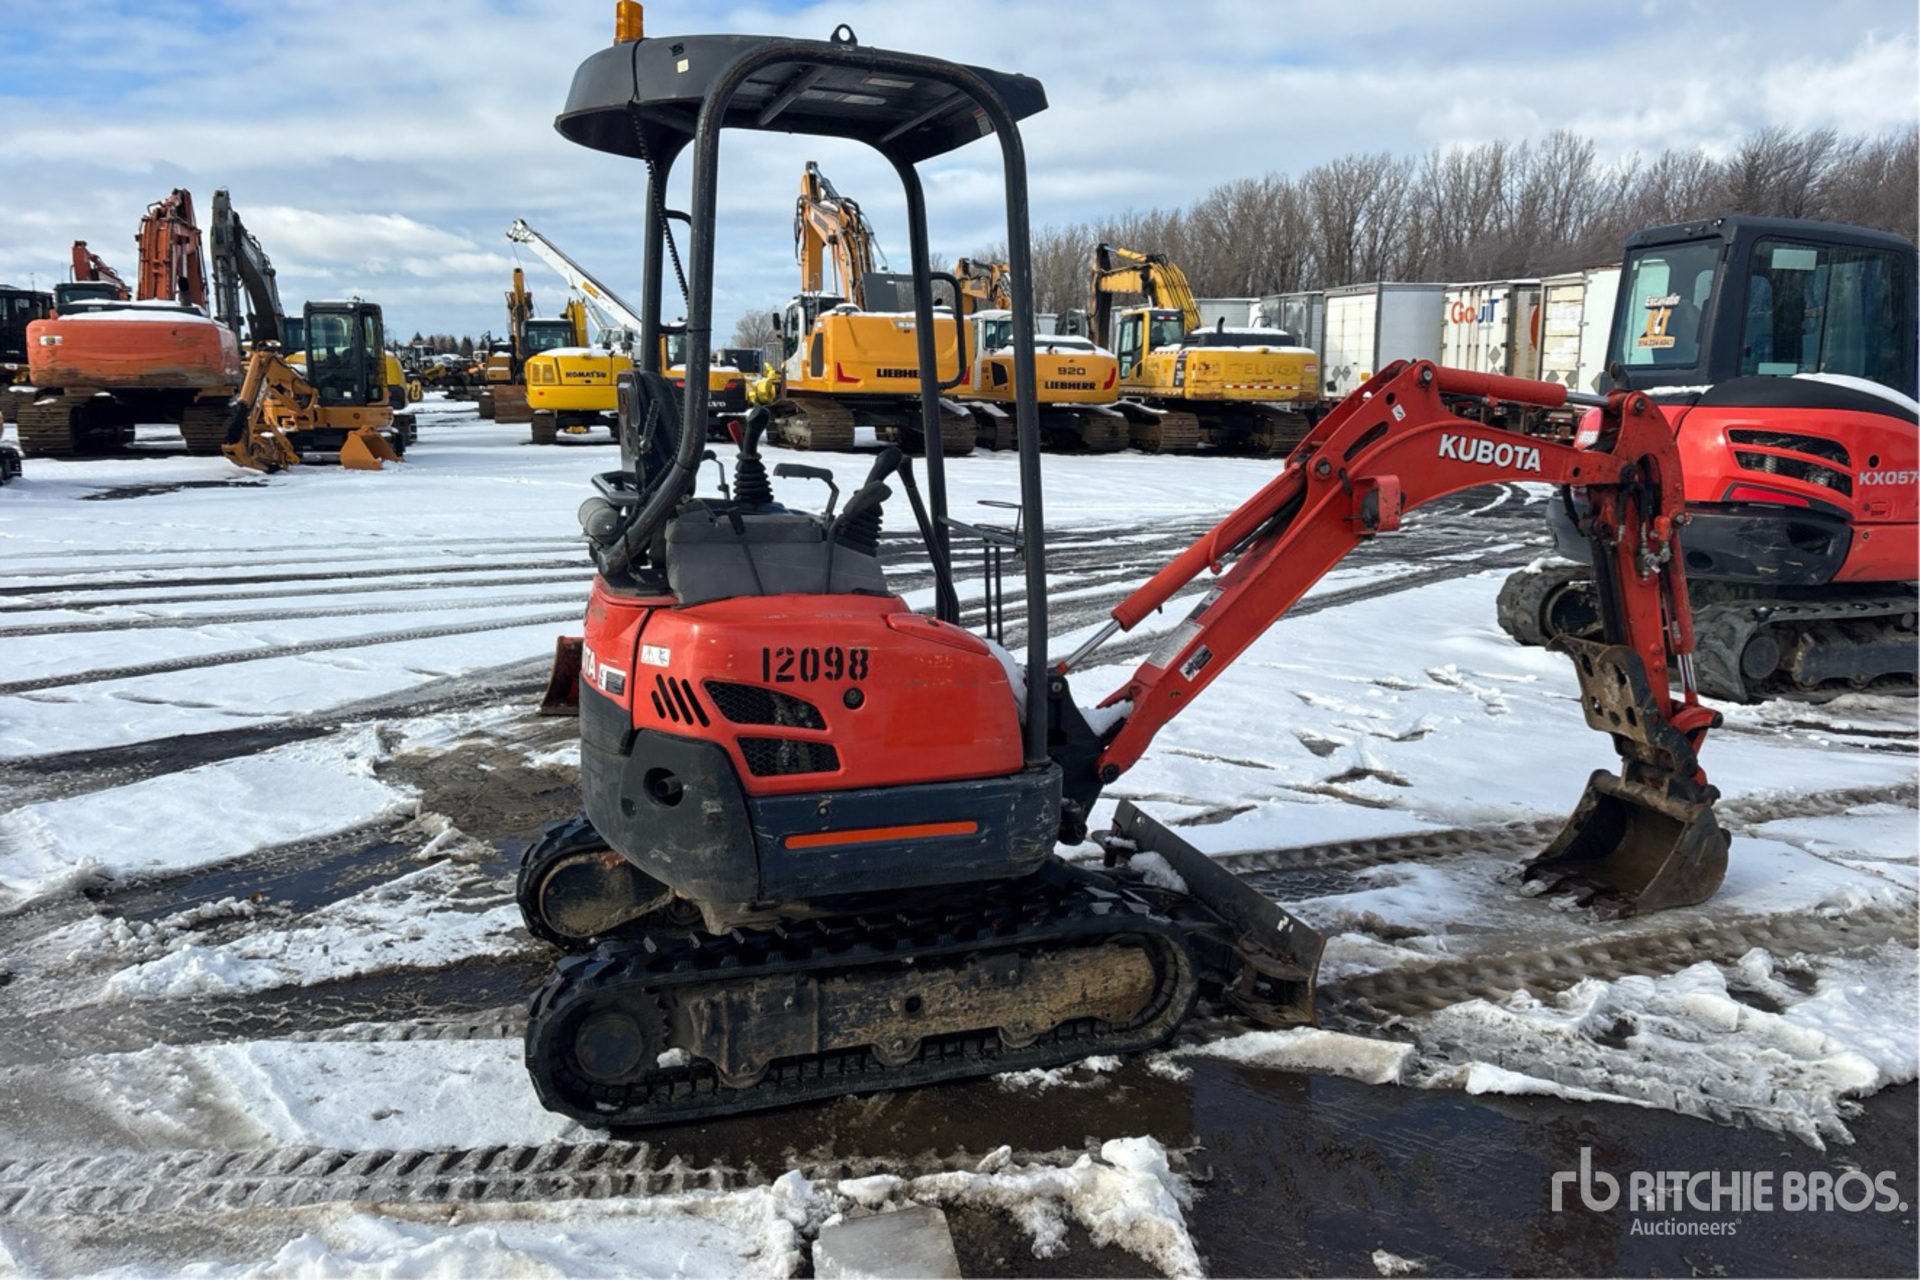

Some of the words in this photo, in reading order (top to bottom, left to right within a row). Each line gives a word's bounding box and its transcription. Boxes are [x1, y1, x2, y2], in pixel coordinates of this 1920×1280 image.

[876, 368, 919, 379] LIEBHE
[1057, 366, 1086, 375] 920
[1044, 381, 1096, 390] LIEBHERR
[1438, 433, 1541, 472] KUBOTA
[762, 646, 868, 682] 12098
